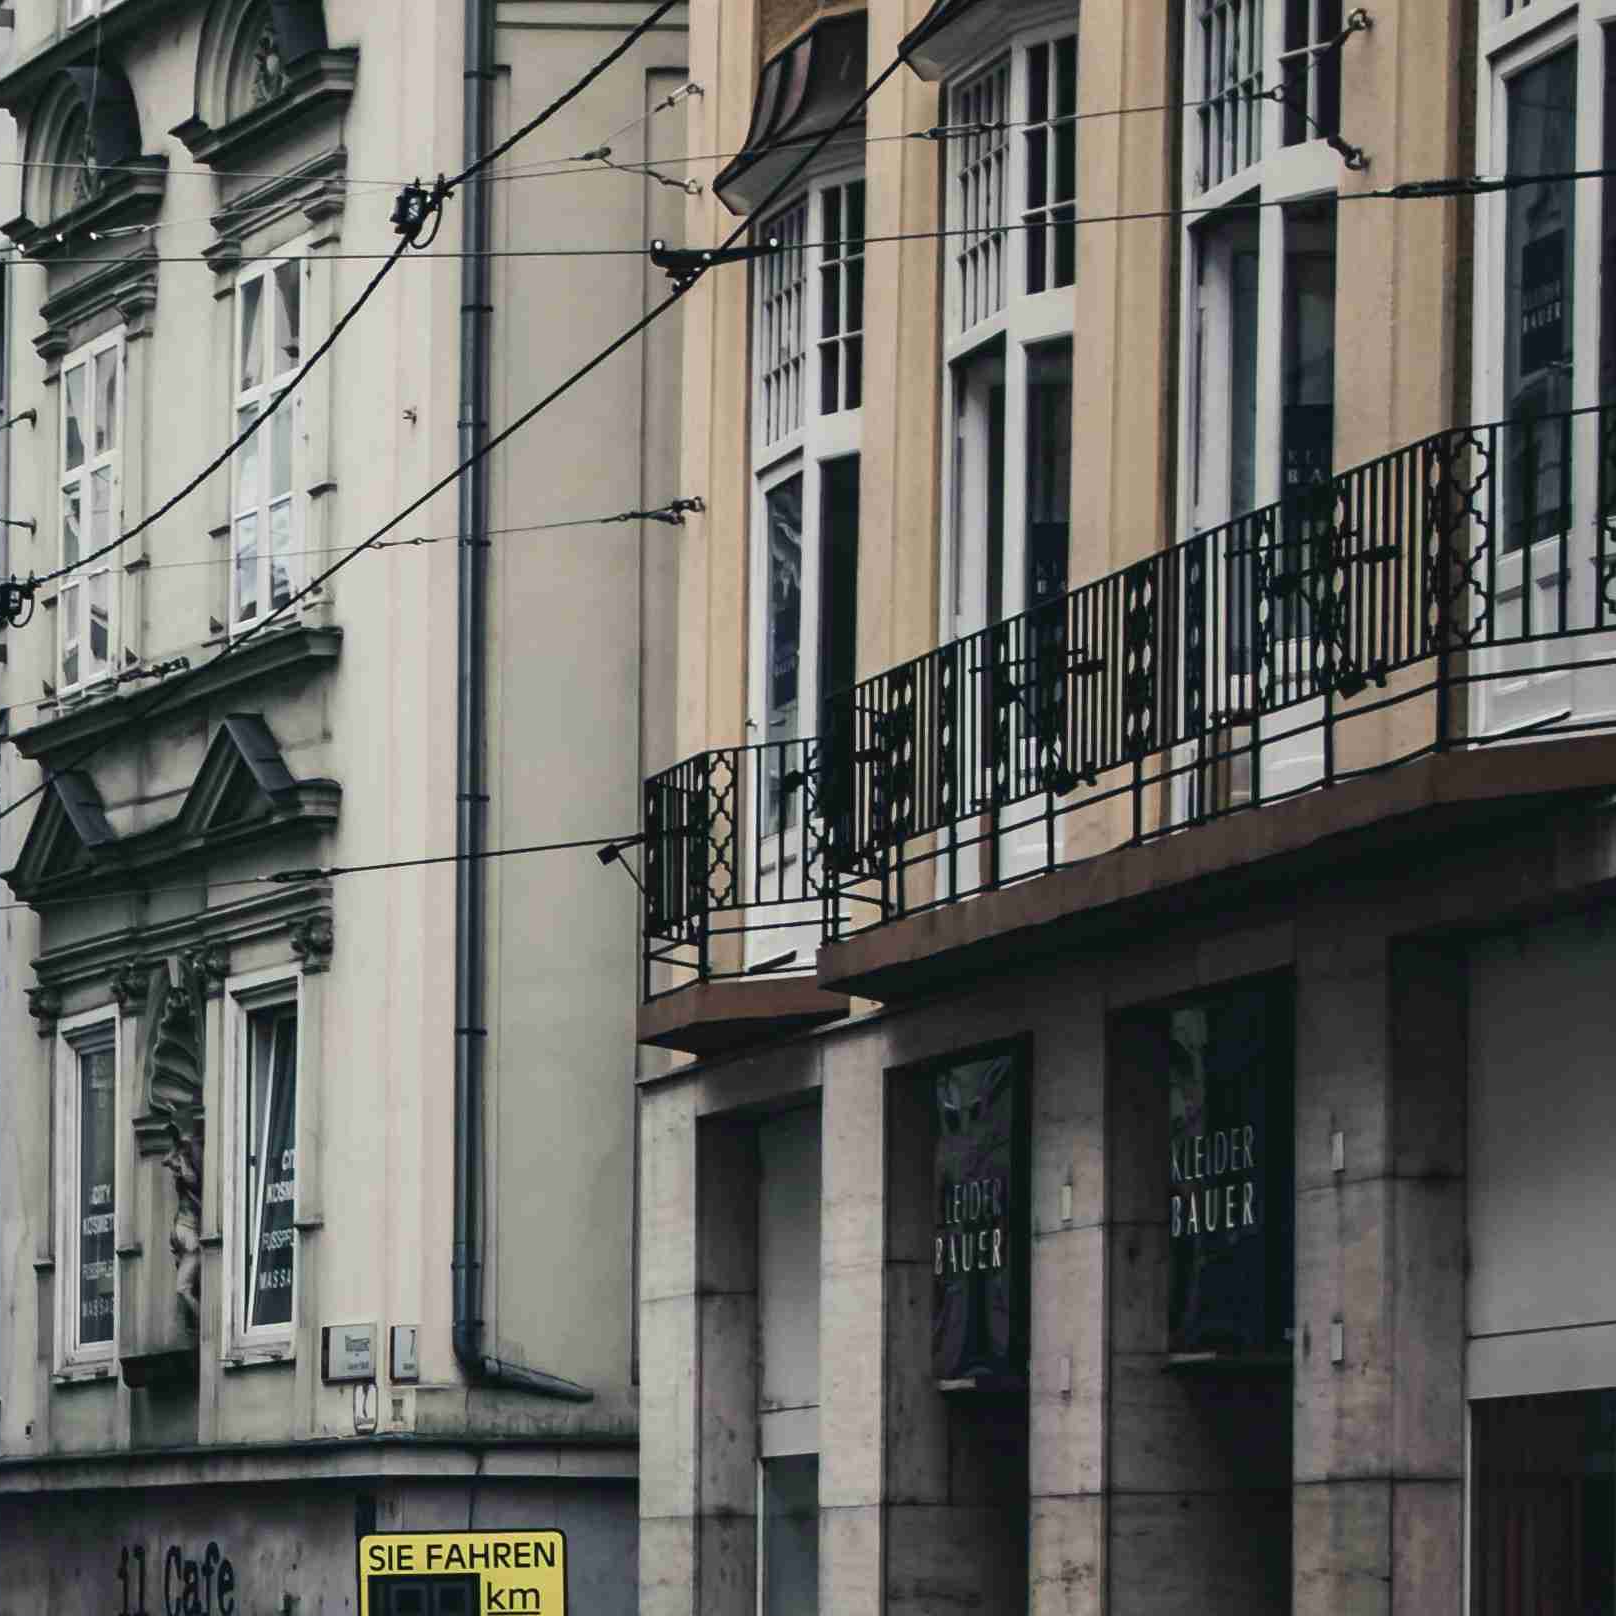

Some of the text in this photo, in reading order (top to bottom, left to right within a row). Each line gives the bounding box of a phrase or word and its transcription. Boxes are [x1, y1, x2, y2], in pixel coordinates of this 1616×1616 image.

[1170, 1124, 1255, 1182] KLEIDER
[944, 1178, 1003, 1224] LEIDER
[1171, 1182, 1255, 1238] BAUER
[934, 1227, 1002, 1275] BAUER
[369, 1541, 556, 1571] SIE FAHREN
[487, 1582, 540, 1610] km
